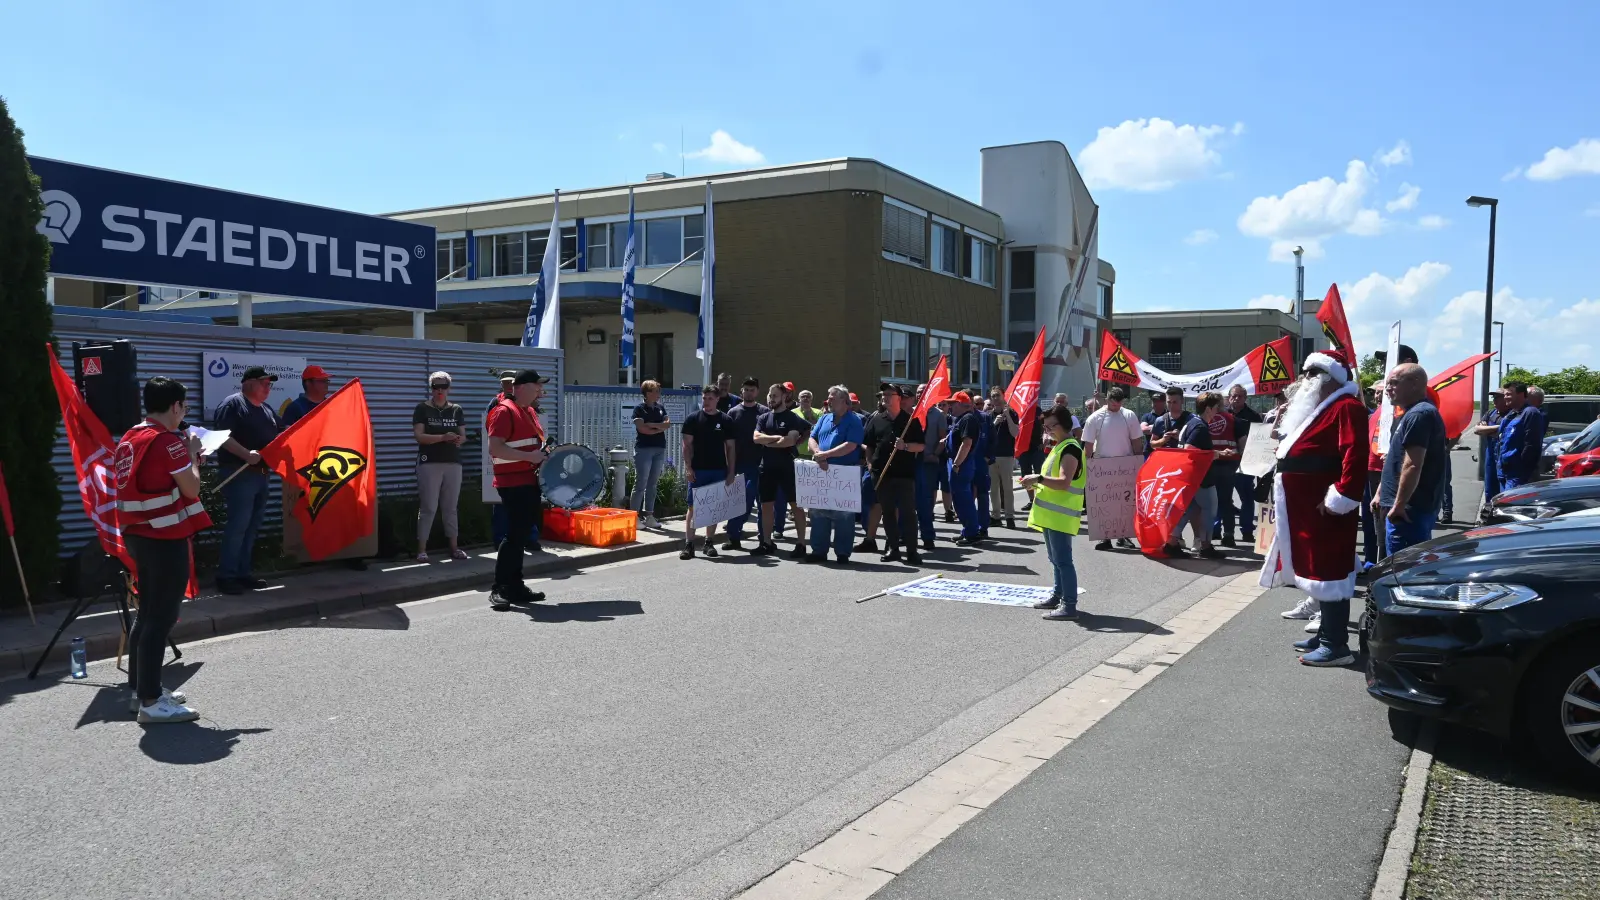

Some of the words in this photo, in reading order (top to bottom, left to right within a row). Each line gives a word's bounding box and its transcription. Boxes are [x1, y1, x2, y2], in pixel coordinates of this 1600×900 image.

[1191, 379, 1224, 393] Geld
[1258, 383, 1269, 393] IG
[796, 466, 839, 480] UNSERE
[816, 488, 829, 496] IST
[800, 495, 829, 506] MEHR
[835, 499, 859, 509] WERT
